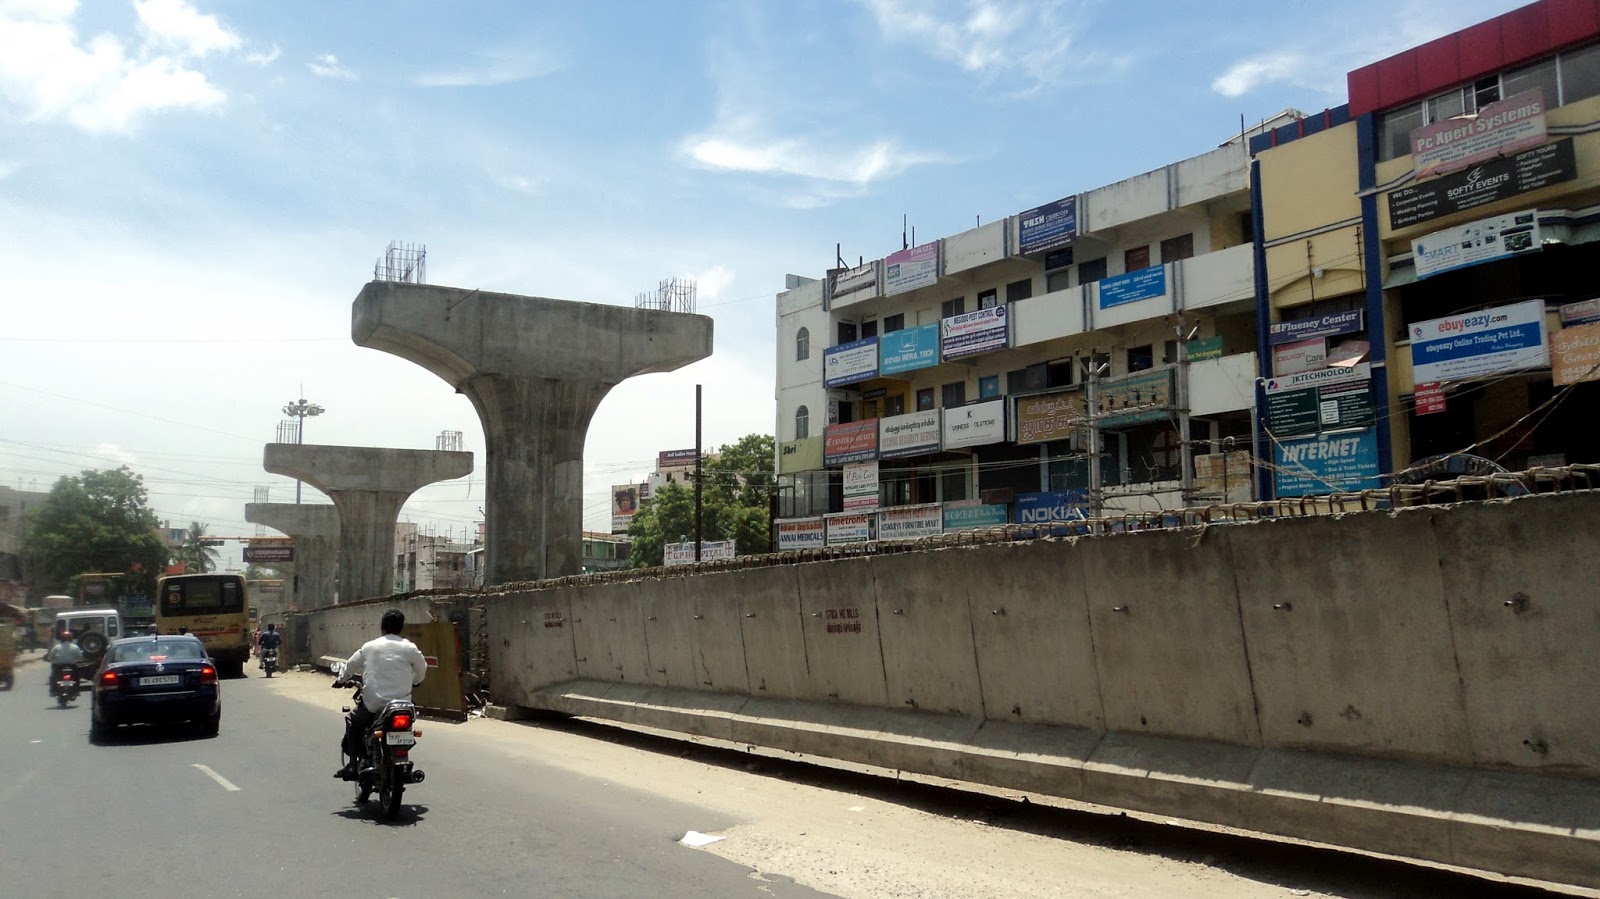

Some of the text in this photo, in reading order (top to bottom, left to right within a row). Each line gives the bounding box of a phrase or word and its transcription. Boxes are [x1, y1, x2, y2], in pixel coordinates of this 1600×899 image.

[1417, 102, 1540, 151] Pc Xpert Systems
[1447, 173, 1509, 197] SOFTY EVENTS
[910, 243, 934, 257] PAUL
[1424, 244, 1459, 262] SMART
[1281, 320, 1320, 332] Fluency
[1322, 313, 1357, 324] Center
[1438, 313, 1508, 333] ebuyeazy.com
[1454, 338, 1473, 347] Online
[1474, 333, 1497, 343] Trading
[1498, 331, 1508, 340] Pvt
[919, 349, 934, 358] TECH
[1305, 353, 1324, 363] Care
[783, 444, 797, 456] Shri
[1282, 437, 1360, 463] INTERNET
[829, 515, 867, 526] timetronic
[1021, 507, 1078, 521] NOKIA
[925, 519, 939, 528] MART
[796, 532, 824, 542] MEDICALS
